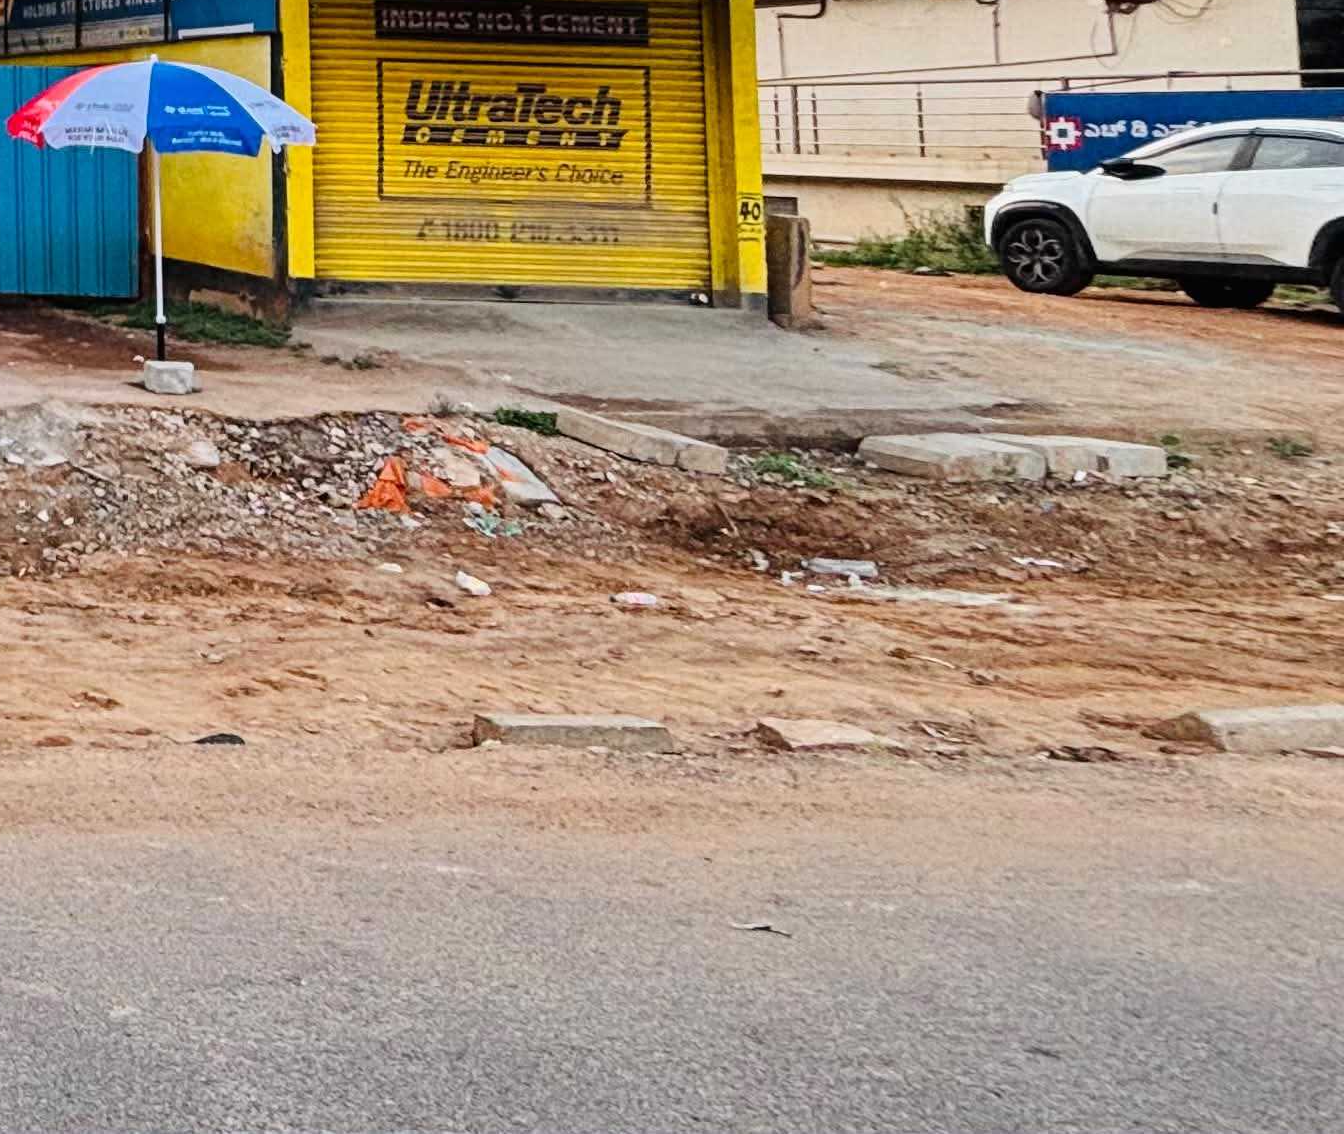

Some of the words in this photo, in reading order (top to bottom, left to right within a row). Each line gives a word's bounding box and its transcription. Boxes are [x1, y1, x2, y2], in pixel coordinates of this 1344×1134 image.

[382, 9, 473, 29] INDIA'S
[540, 13, 641, 35] CEMENT
[405, 79, 622, 126] UltraTech
[415, 127, 613, 147] CEMENT
[403, 161, 438, 178] The
[445, 161, 549, 183] Engineer's
[555, 163, 624, 185] Choice
